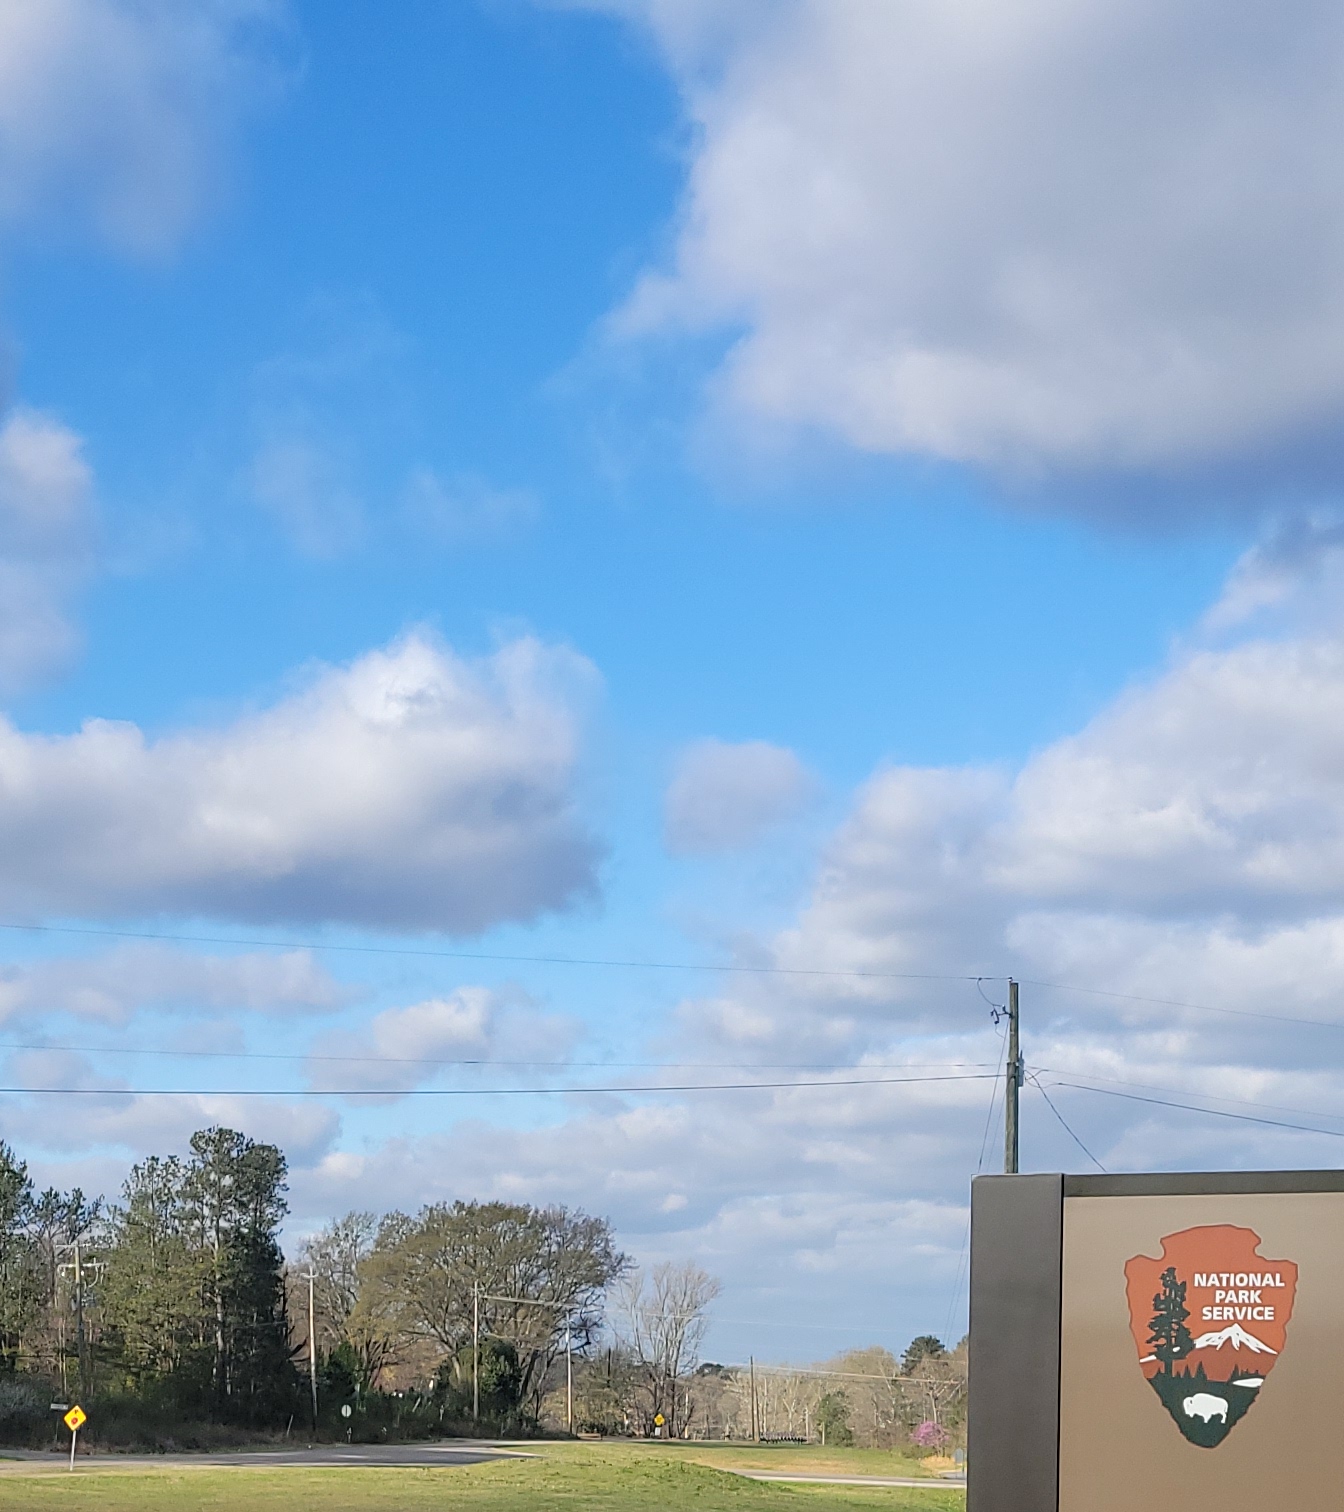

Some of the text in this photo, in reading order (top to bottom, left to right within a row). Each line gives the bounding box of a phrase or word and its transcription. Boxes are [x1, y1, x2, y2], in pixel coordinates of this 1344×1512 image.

[1193, 1273, 1285, 1287] NATIONAL
[1214, 1290, 1262, 1304] PARK
[1201, 1306, 1275, 1321] SERVICE
